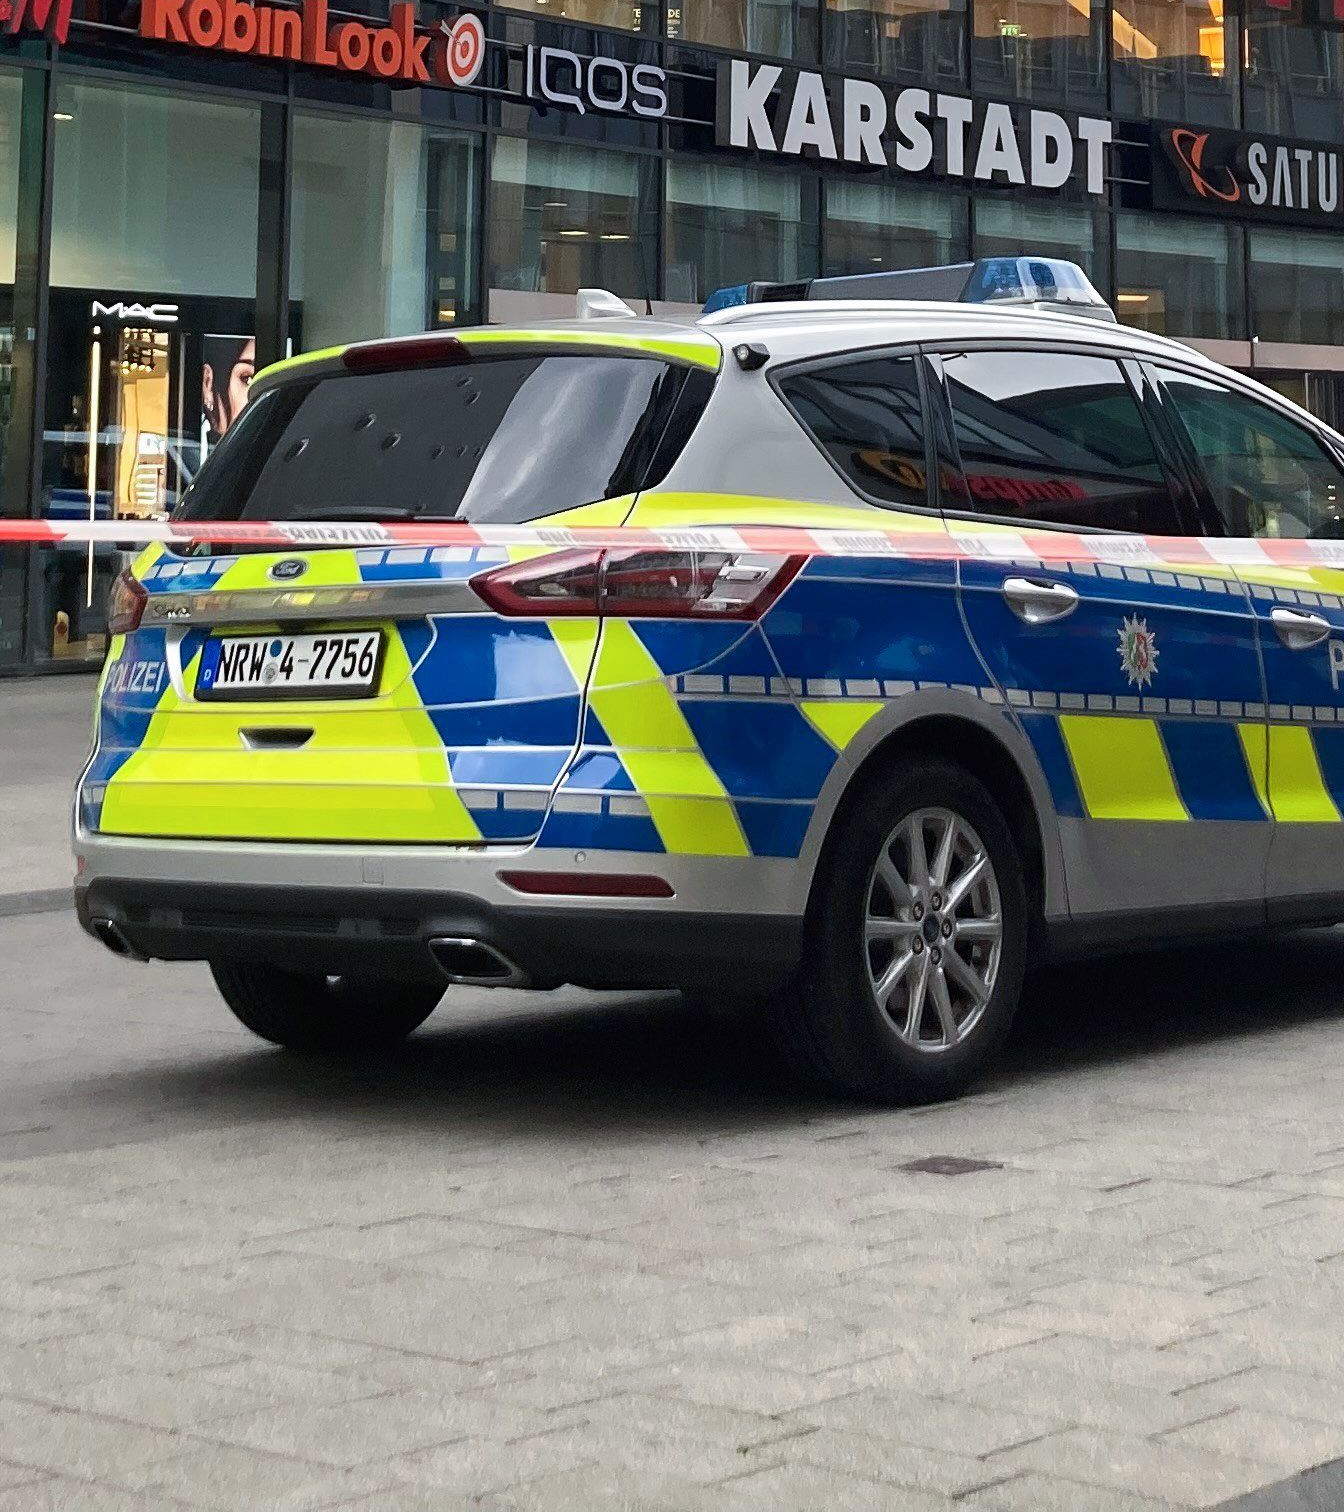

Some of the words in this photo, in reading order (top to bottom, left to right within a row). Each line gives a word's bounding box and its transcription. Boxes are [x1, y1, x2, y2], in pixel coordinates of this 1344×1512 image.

[526, 43, 668, 117] IQOS
[728, 59, 1112, 194] KARSTADT
[104, 660, 166, 694] POLIZEI
[203, 668, 212, 681] D
[214, 641, 269, 683] NRW
[279, 638, 375, 681] 4-7756
